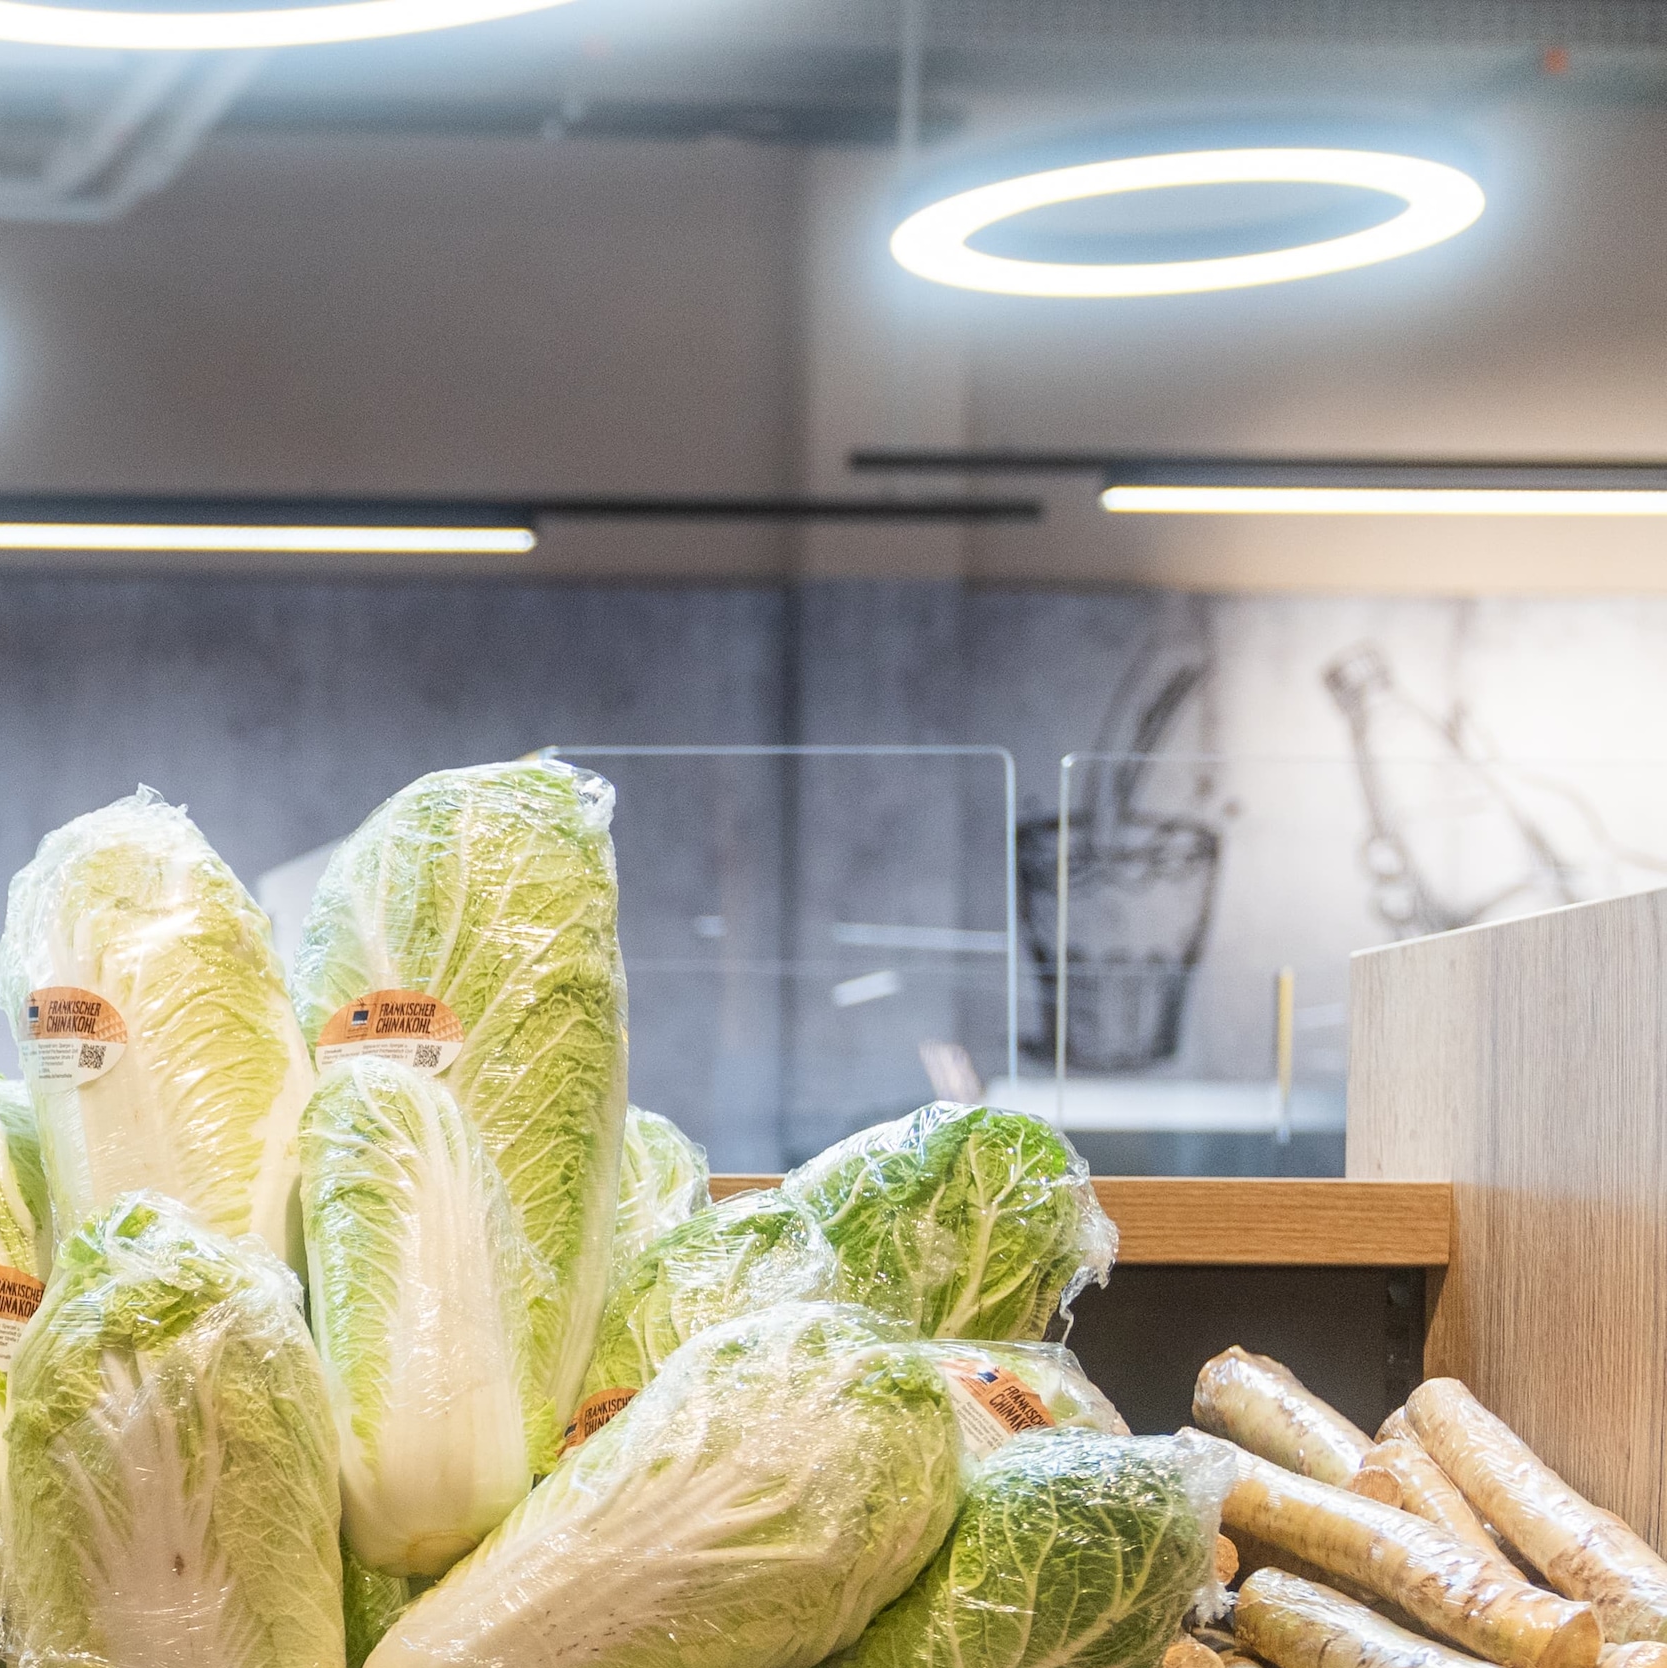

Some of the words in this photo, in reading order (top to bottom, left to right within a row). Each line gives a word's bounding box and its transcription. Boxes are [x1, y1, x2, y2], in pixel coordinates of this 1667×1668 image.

[48, 1000, 101, 1017] FRÄNKISCHER
[379, 1001, 436, 1017] FRÄNKISCHER
[46, 1016, 96, 1034] CHINAKOHL
[376, 1018, 431, 1034] CHINAKOHL
